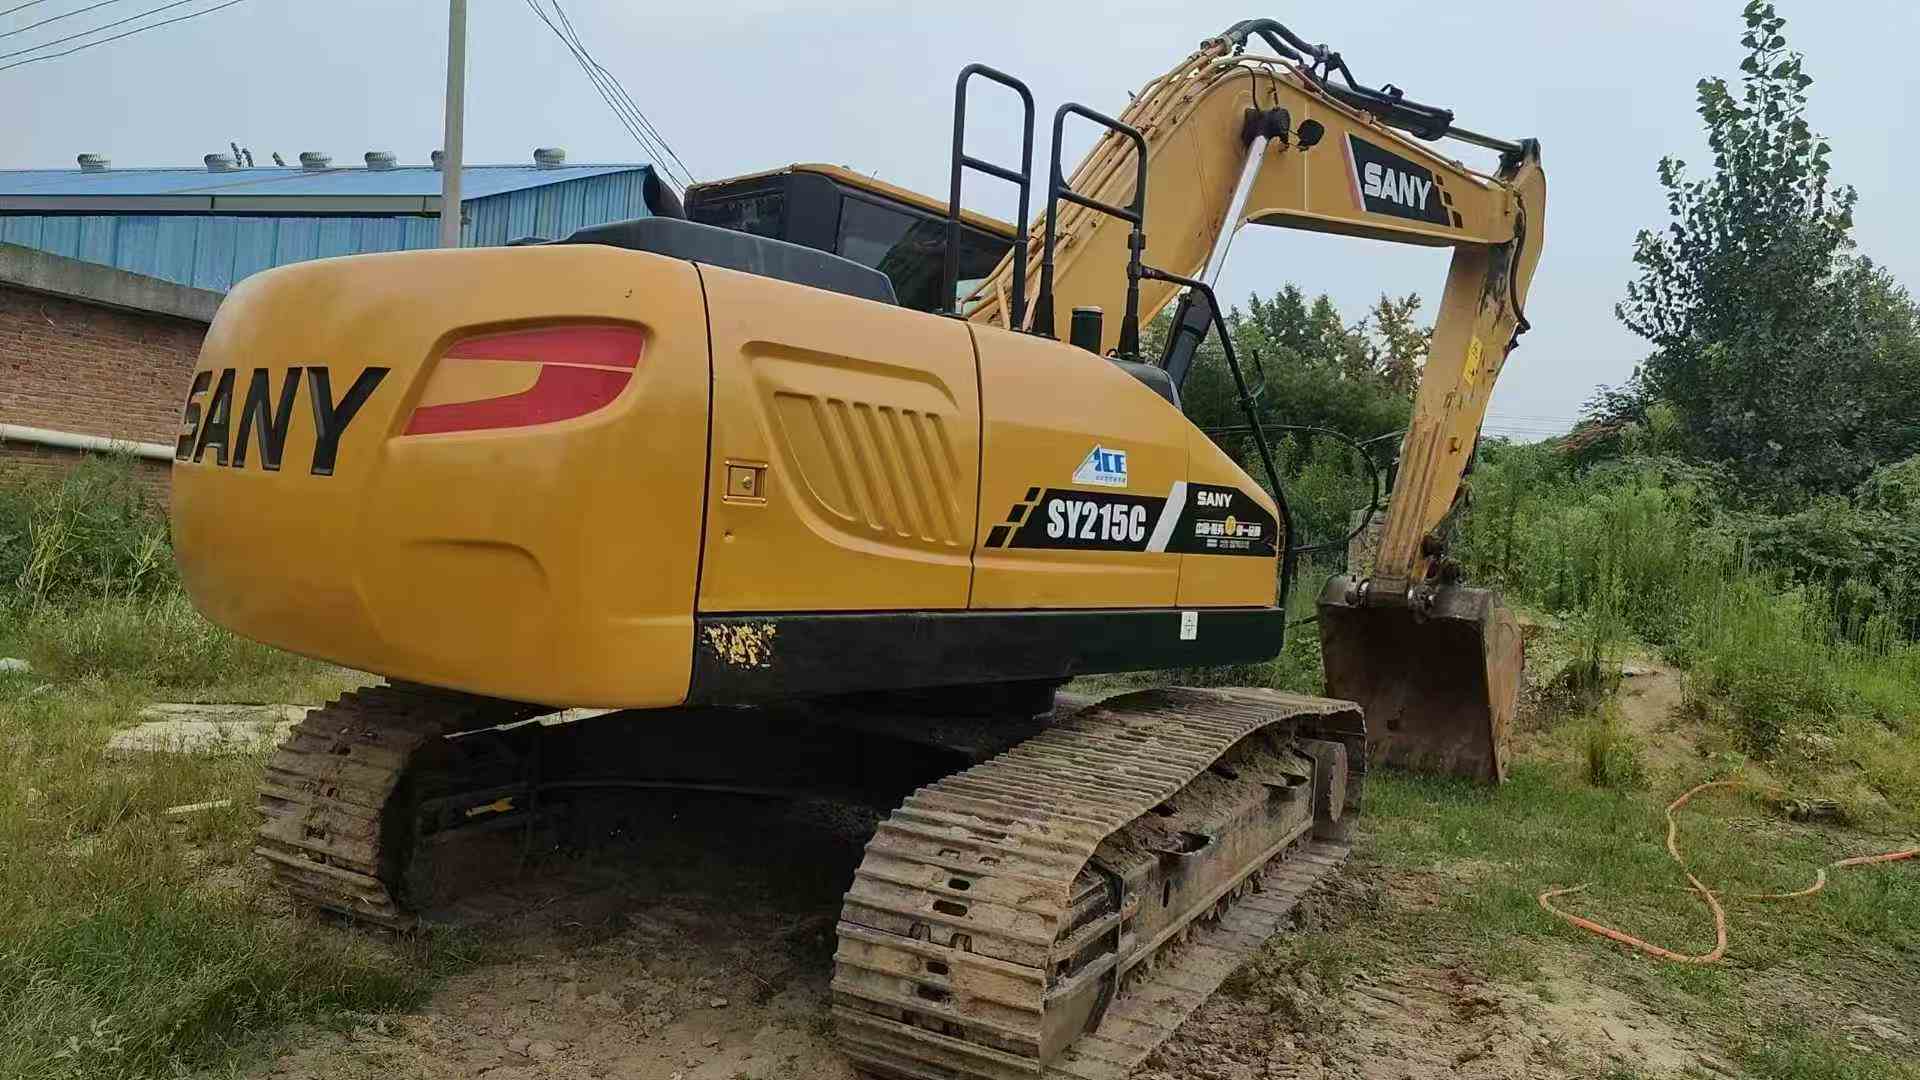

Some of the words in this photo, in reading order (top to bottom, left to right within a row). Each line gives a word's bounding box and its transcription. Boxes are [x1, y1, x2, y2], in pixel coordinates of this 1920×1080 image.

[1364, 161, 1432, 210] SANY
[176, 367, 391, 475] SANY
[1047, 499, 1147, 542] SY215C
[1197, 491, 1233, 508] SANY
